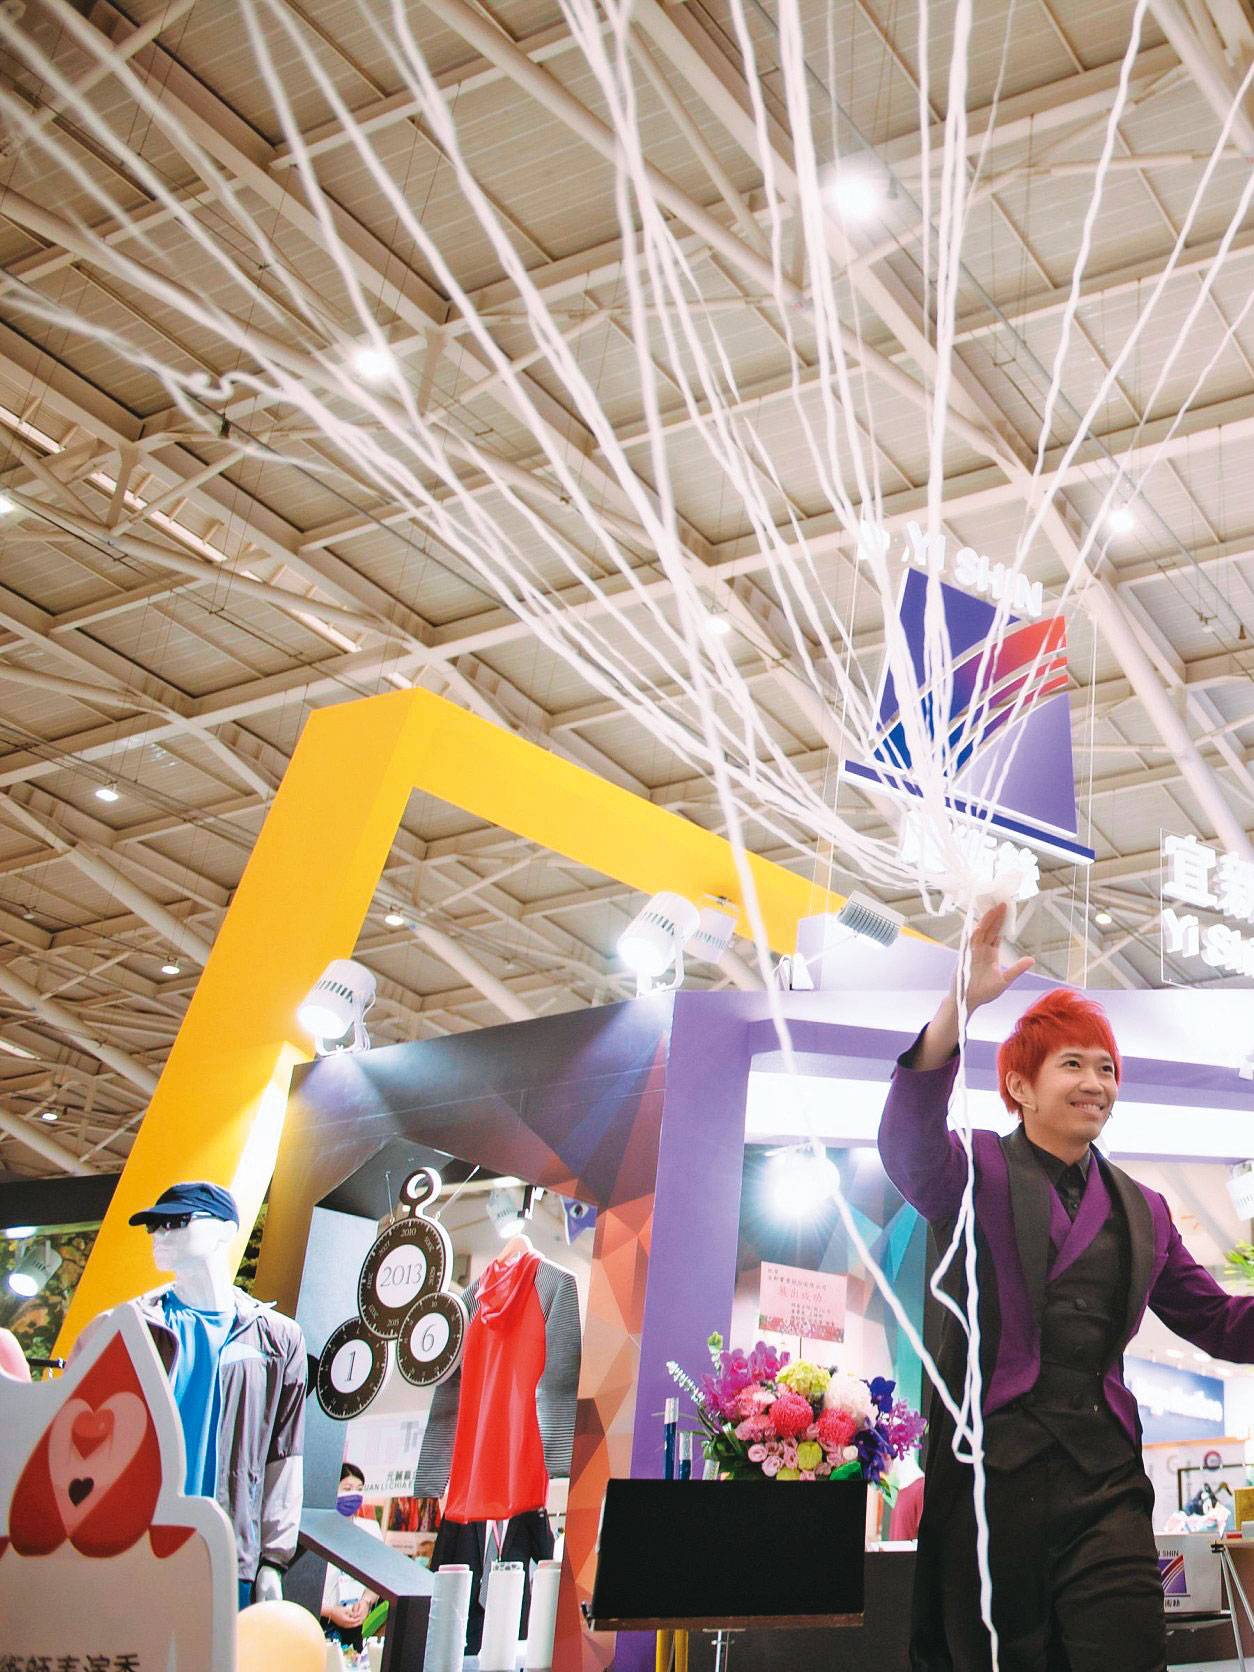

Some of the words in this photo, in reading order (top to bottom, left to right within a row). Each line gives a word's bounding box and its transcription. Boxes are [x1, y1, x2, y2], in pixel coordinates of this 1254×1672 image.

[954, 546, 1043, 618] SHIN
[1161, 907, 1200, 958] Yi
[380, 1263, 423, 1288] 2013
[421, 1323, 436, 1353] 6
[344, 1350, 357, 1382] 1
